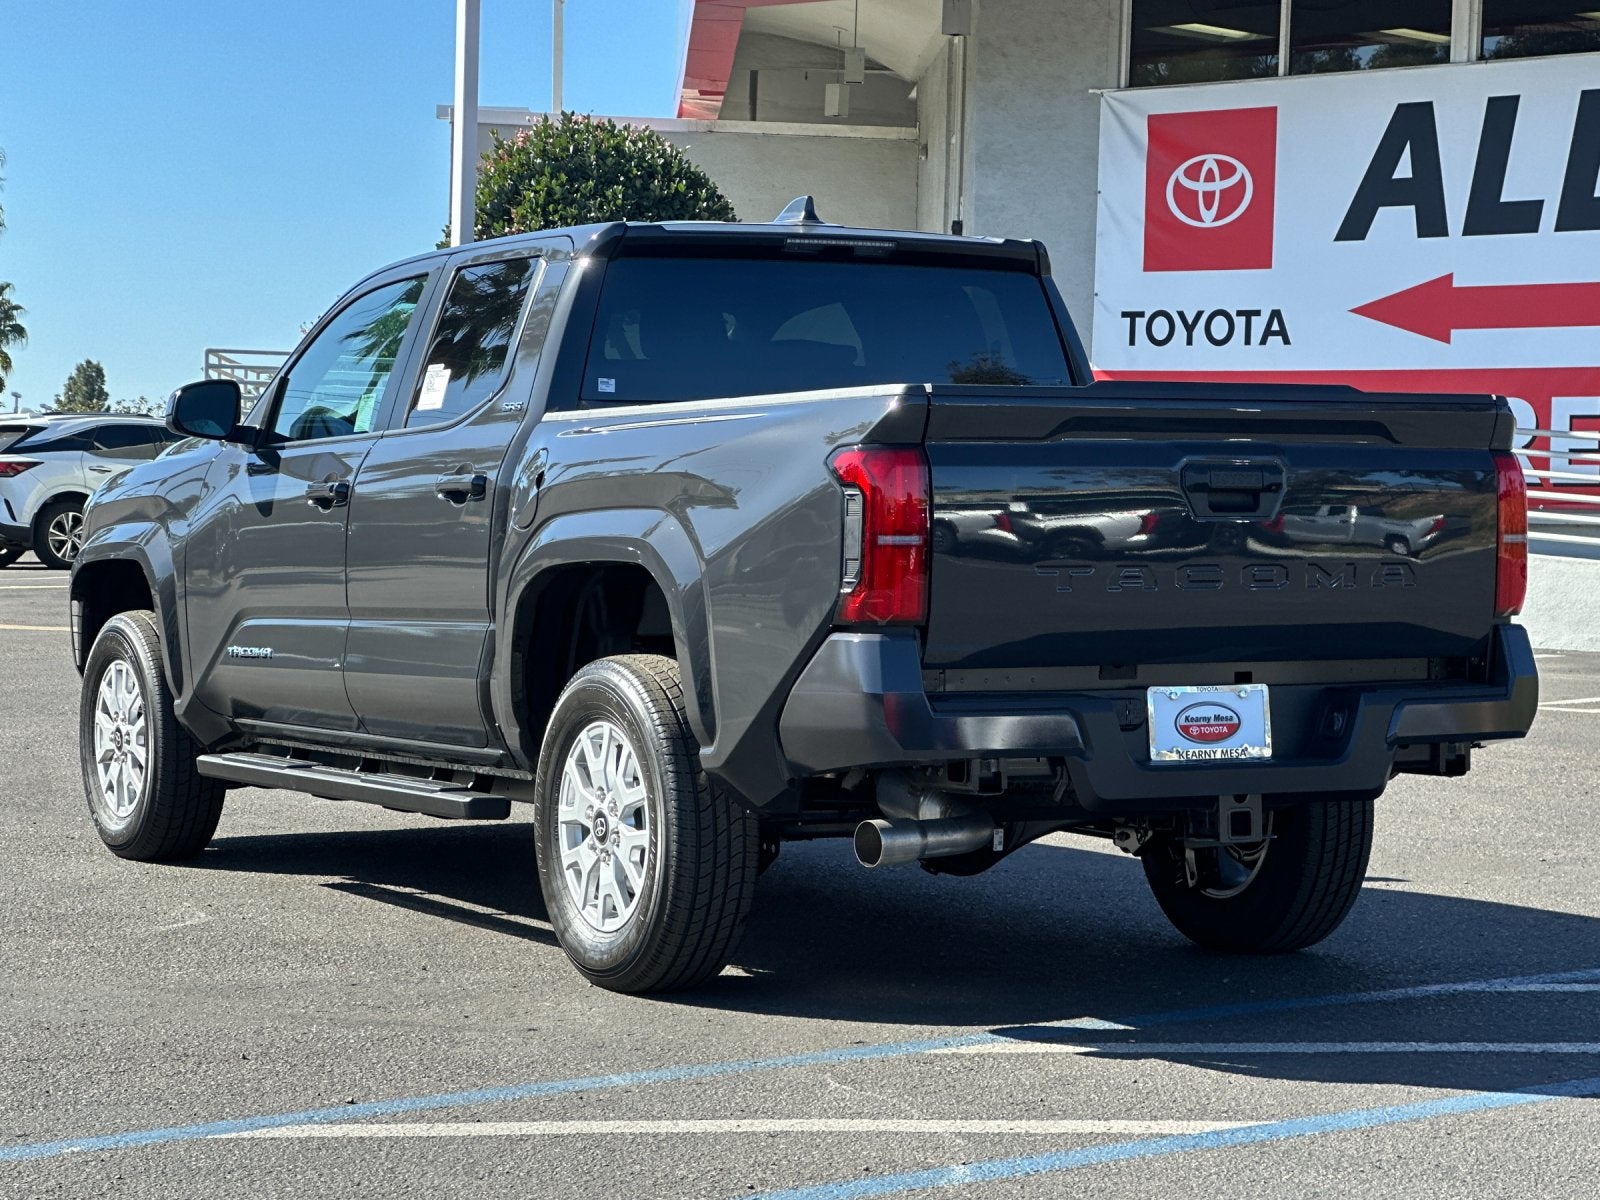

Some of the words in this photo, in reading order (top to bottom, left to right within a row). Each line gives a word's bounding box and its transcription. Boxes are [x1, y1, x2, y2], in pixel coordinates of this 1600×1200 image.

[1121, 308, 1292, 347] TOYOTA
[1034, 563, 1417, 593] TACOMA
[227, 645, 273, 659] TACOMA
[1184, 714, 1212, 724] Kearny
[1213, 714, 1234, 722] Mesa
[1178, 750, 1217, 759] KEARNY
[1220, 749, 1247, 758] MESA
